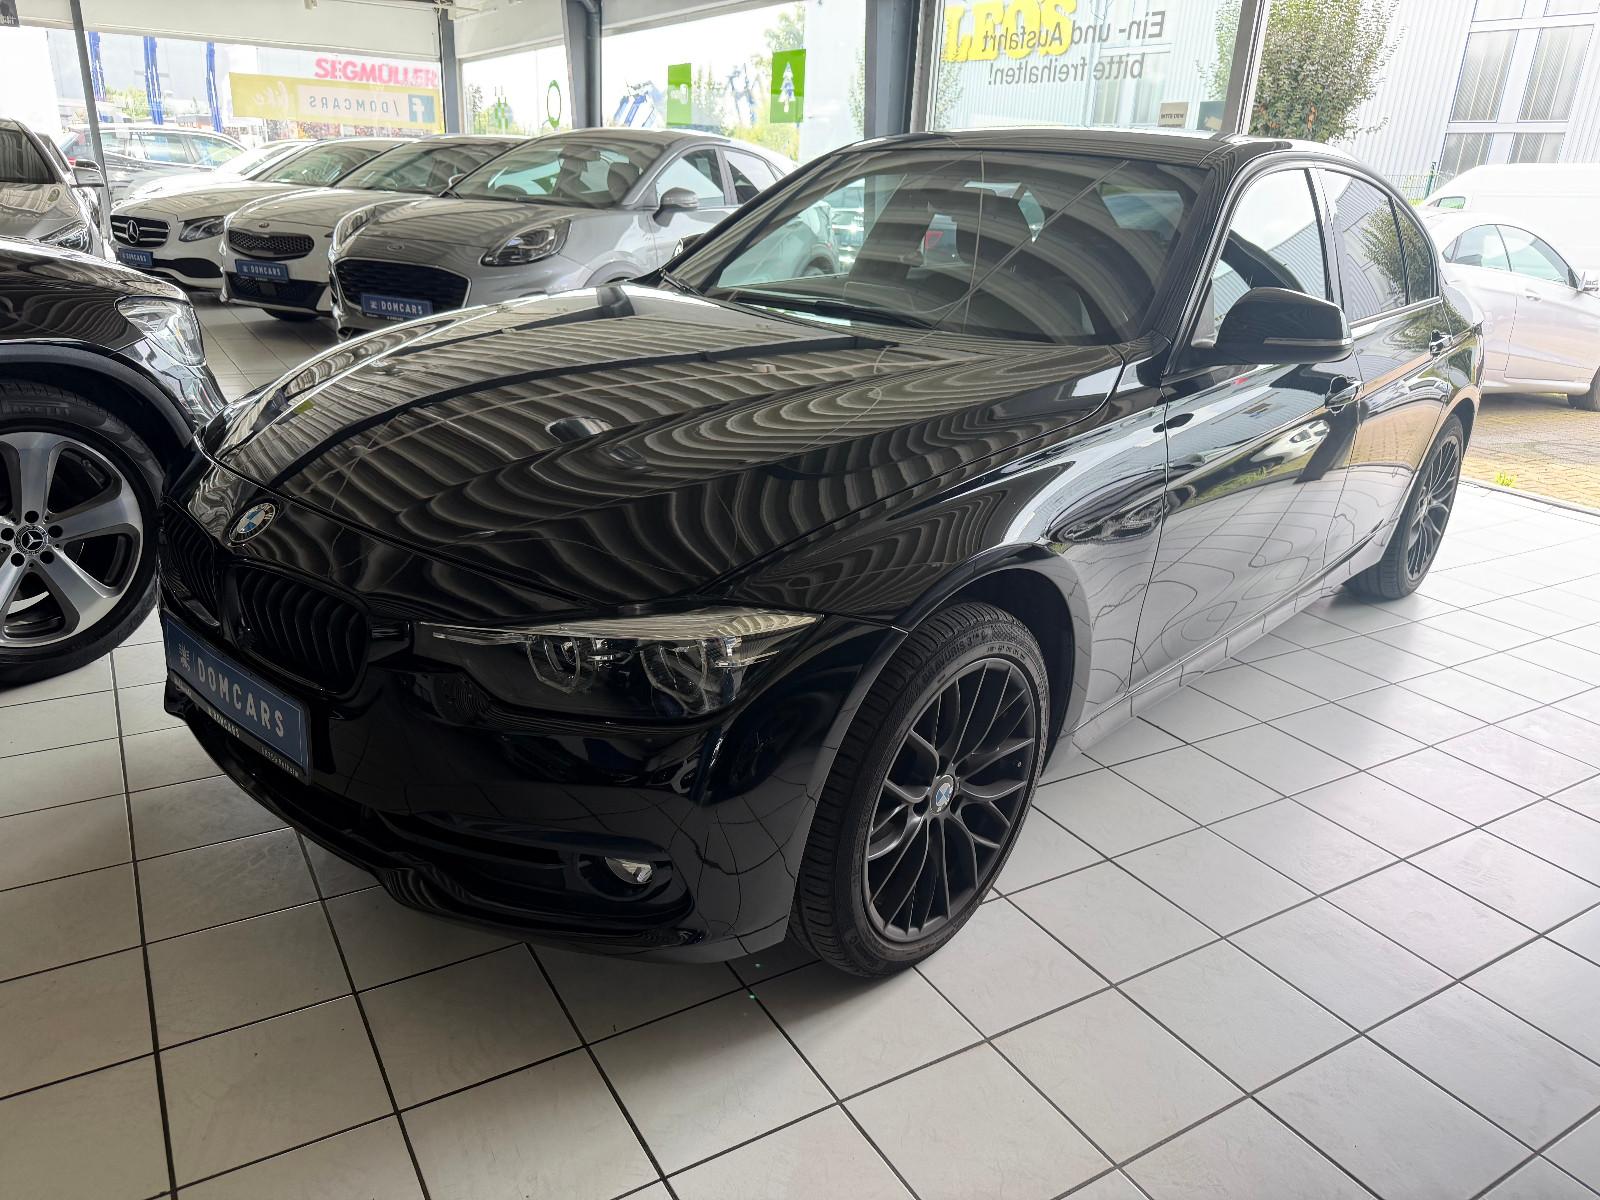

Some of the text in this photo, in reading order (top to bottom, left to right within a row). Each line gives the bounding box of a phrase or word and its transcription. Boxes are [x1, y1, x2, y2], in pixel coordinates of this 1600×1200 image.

[314, 57, 438, 87] SEGMÜLLER
[250, 264, 281, 276] DOMCARS
[381, 300, 422, 314] DOMCARS
[197, 657, 284, 737] DOMCARS
